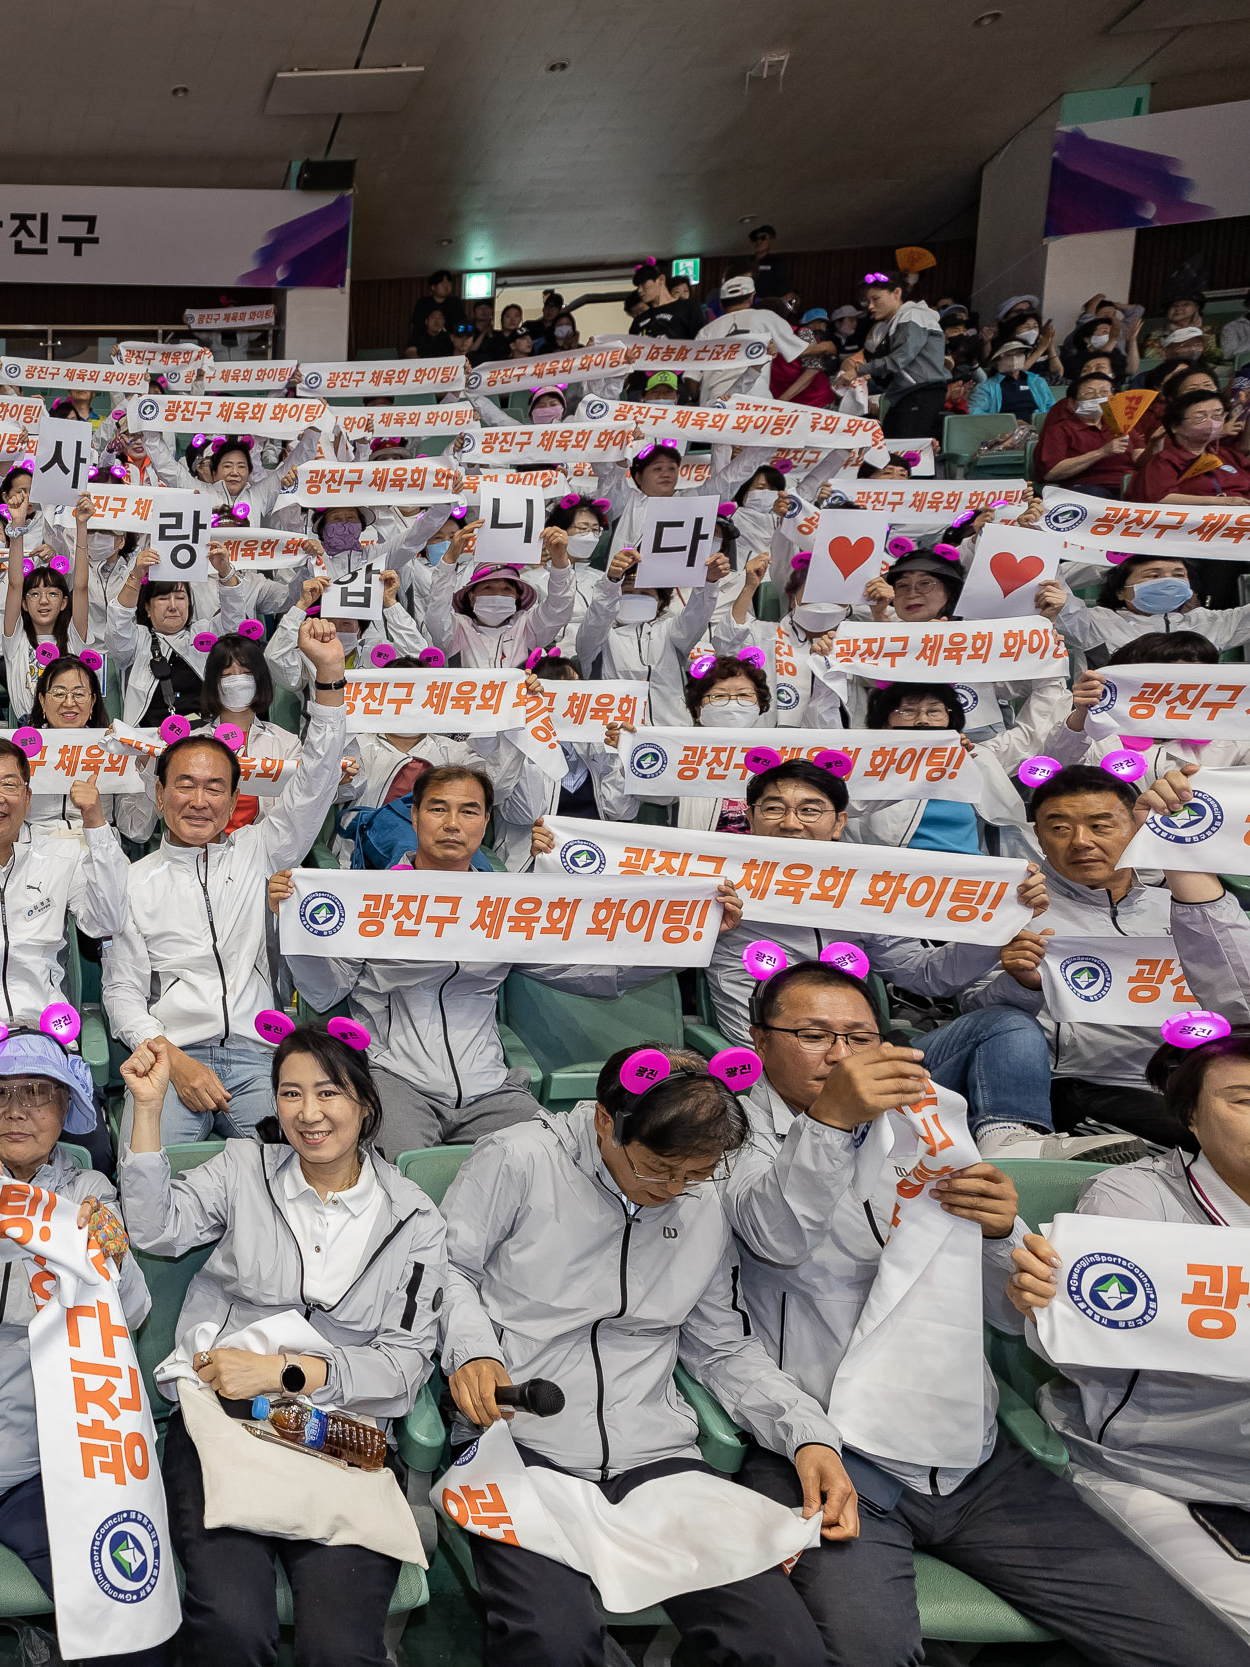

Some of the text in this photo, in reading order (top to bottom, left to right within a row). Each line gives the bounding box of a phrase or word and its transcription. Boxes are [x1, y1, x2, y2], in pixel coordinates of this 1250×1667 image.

[487, 366, 527, 387] 광진구
[532, 358, 575, 378] 체육회
[165, 399, 326, 423] 광진구 체육회 화이팅!
[614, 404, 668, 426] 광진구
[672, 410, 730, 432] 체육회
[732, 415, 799, 436] 화이팅!
[482, 430, 593, 454] 광진구 체육회
[39, 440, 87, 489] 사
[306, 469, 363, 494] 광진구
[368, 467, 428, 492] 체육회
[909, 491, 962, 512] 체육회
[491, 498, 534, 544] 니
[1090, 507, 1188, 539] 광진구
[158, 510, 207, 570] 랑
[652, 517, 708, 567] 다
[915, 632, 992, 666] 체육회
[422, 681, 507, 715] 체육회
[1129, 683, 1246, 720] 광진구
[864, 746, 966, 782] 화이팅!
[730, 859, 857, 912] 체육회
[860, 871, 1009, 922] 화이팅!
[358, 894, 712, 944] 광진구 체육회 화이팅!
[756, 951, 776, 967] 광진
[833, 952, 858, 970] 광진
[52, 1014, 72, 1030] 광진
[1179, 1026, 1212, 1038] 광진
[635, 1066, 658, 1080] 광진
[726, 1064, 751, 1078] 광진
[66, 1300, 149, 1485] 광진구
